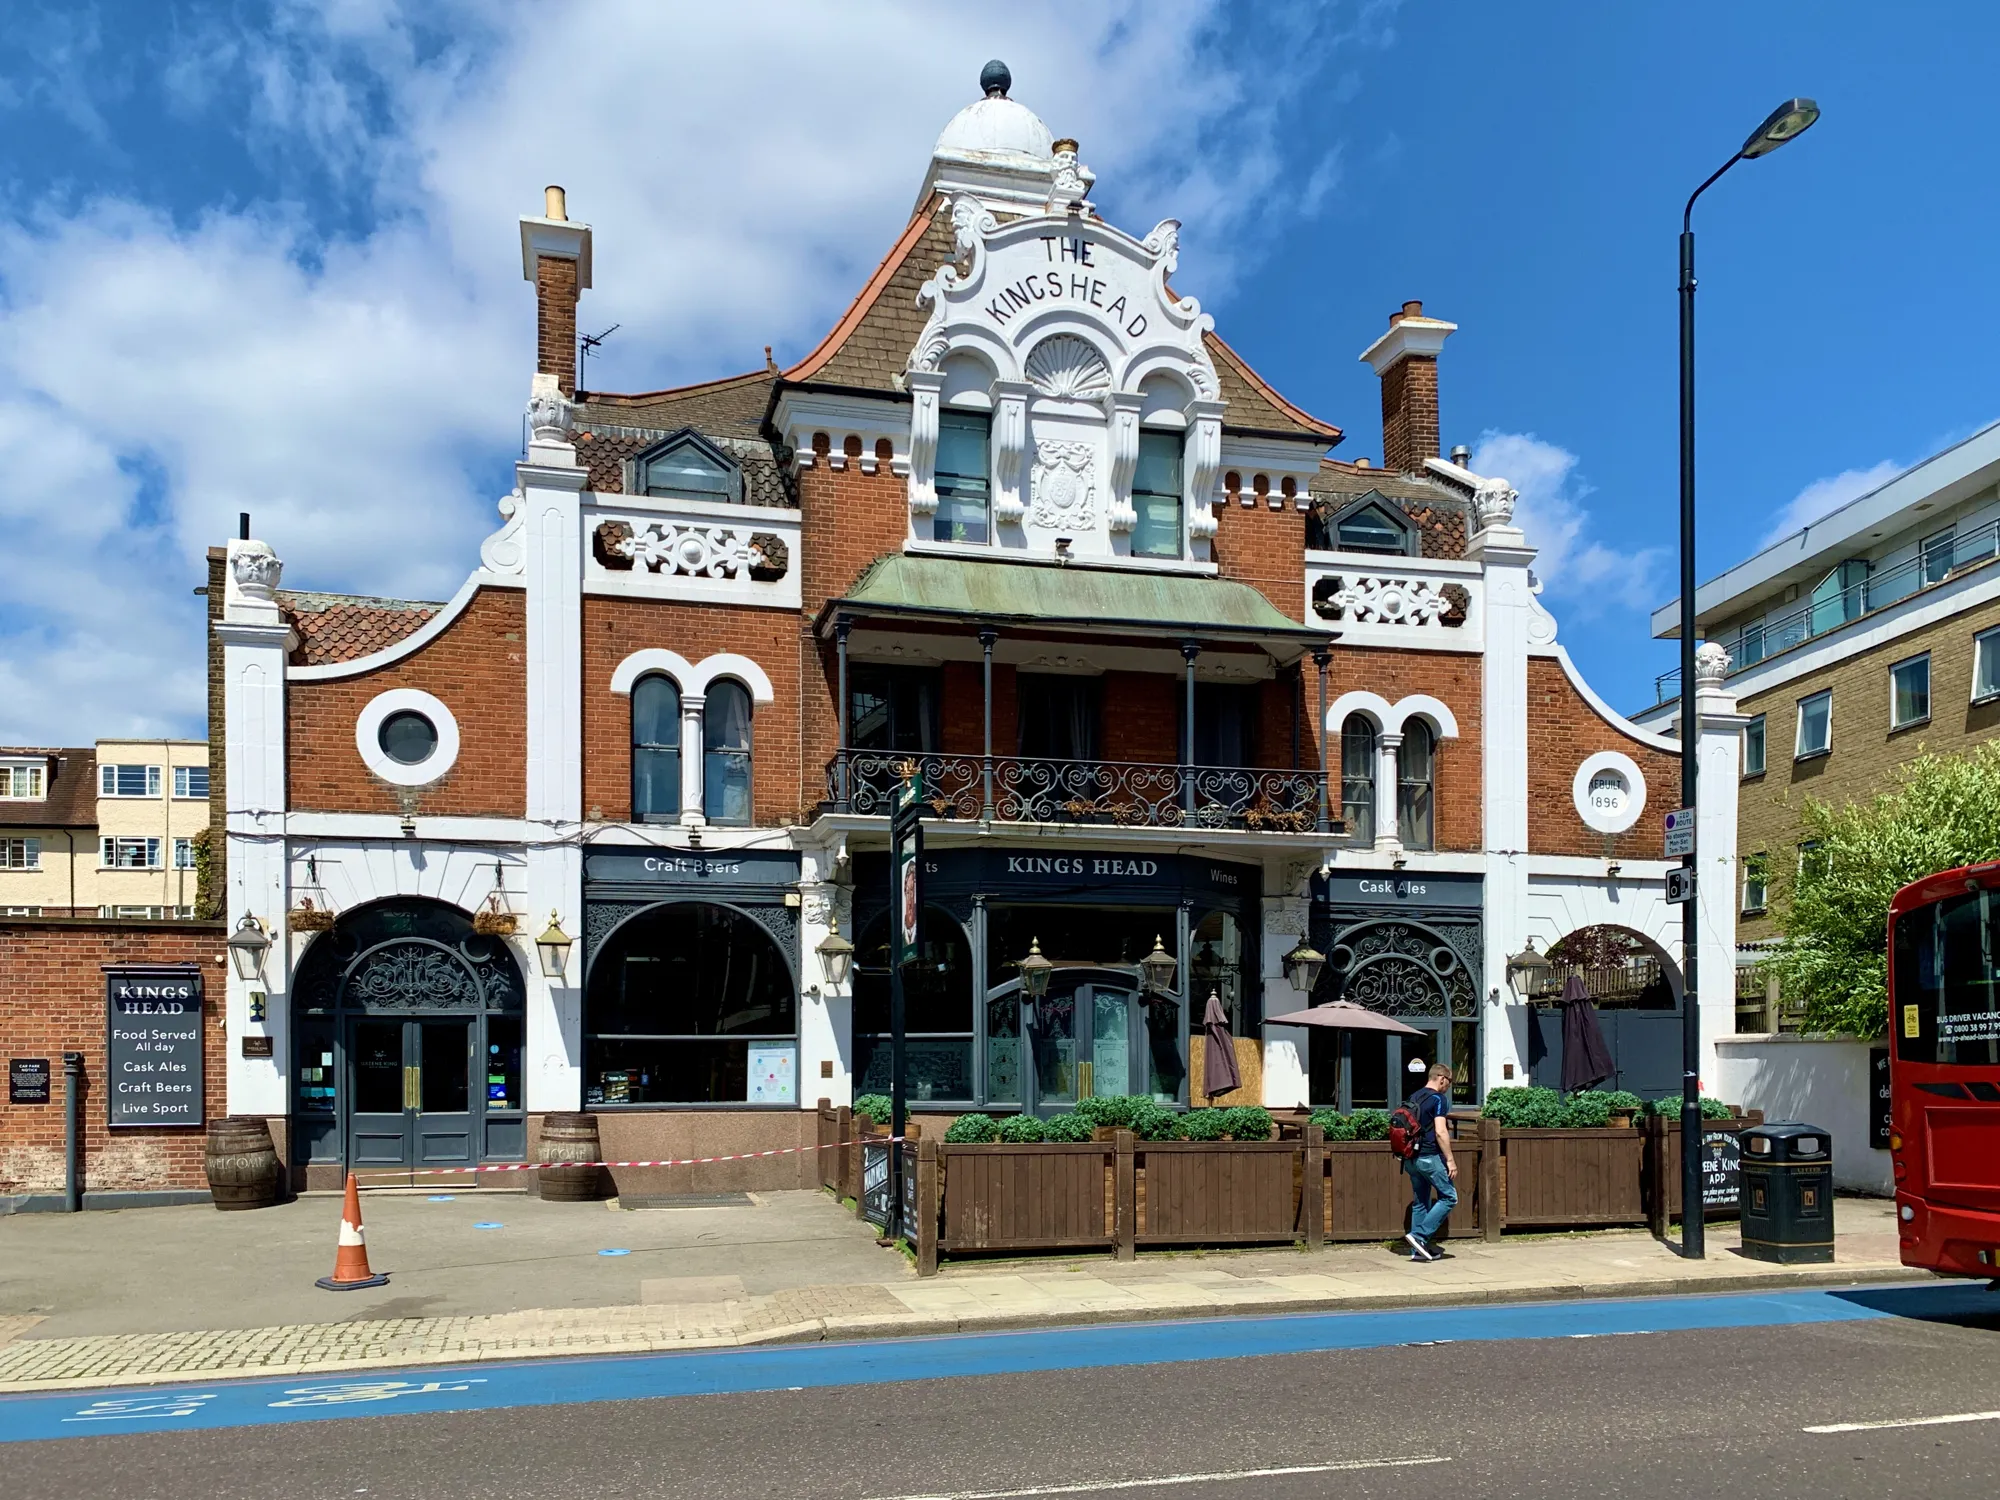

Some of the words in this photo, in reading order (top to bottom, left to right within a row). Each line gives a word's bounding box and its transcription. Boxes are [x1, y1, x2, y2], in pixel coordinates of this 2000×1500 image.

[1040, 236, 1095, 268] THE
[986, 271, 1063, 326] KINGS
[1070, 273, 1148, 338] HEAD
[1588, 779, 1621, 790] REBUILT
[1591, 796, 1618, 808] 1896
[644, 858, 687, 872] Craft
[694, 859, 740, 874] Beers
[1008, 856, 1084, 874] KINGS
[1092, 860, 1158, 876] HEAD
[1210, 869, 1238, 884] Wines
[1359, 880, 1392, 893] Cask
[1396, 881, 1426, 894] Ales
[120, 986, 188, 999] KINGS
[124, 1002, 184, 1015] HEAD
[1949, 1014, 1971, 1022] DRIVER
[114, 1030, 146, 1040] Food
[152, 1030, 196, 1040] Served
[135, 1042, 150, 1051] All
[155, 1043, 175, 1053] day
[124, 1062, 154, 1072] Cask
[159, 1062, 187, 1072] Ales
[118, 1082, 152, 1093] Craft
[156, 1082, 192, 1092] Beers
[122, 1103, 148, 1113] Live
[153, 1103, 189, 1115] Sport
[1709, 1173, 1726, 1184] APP
